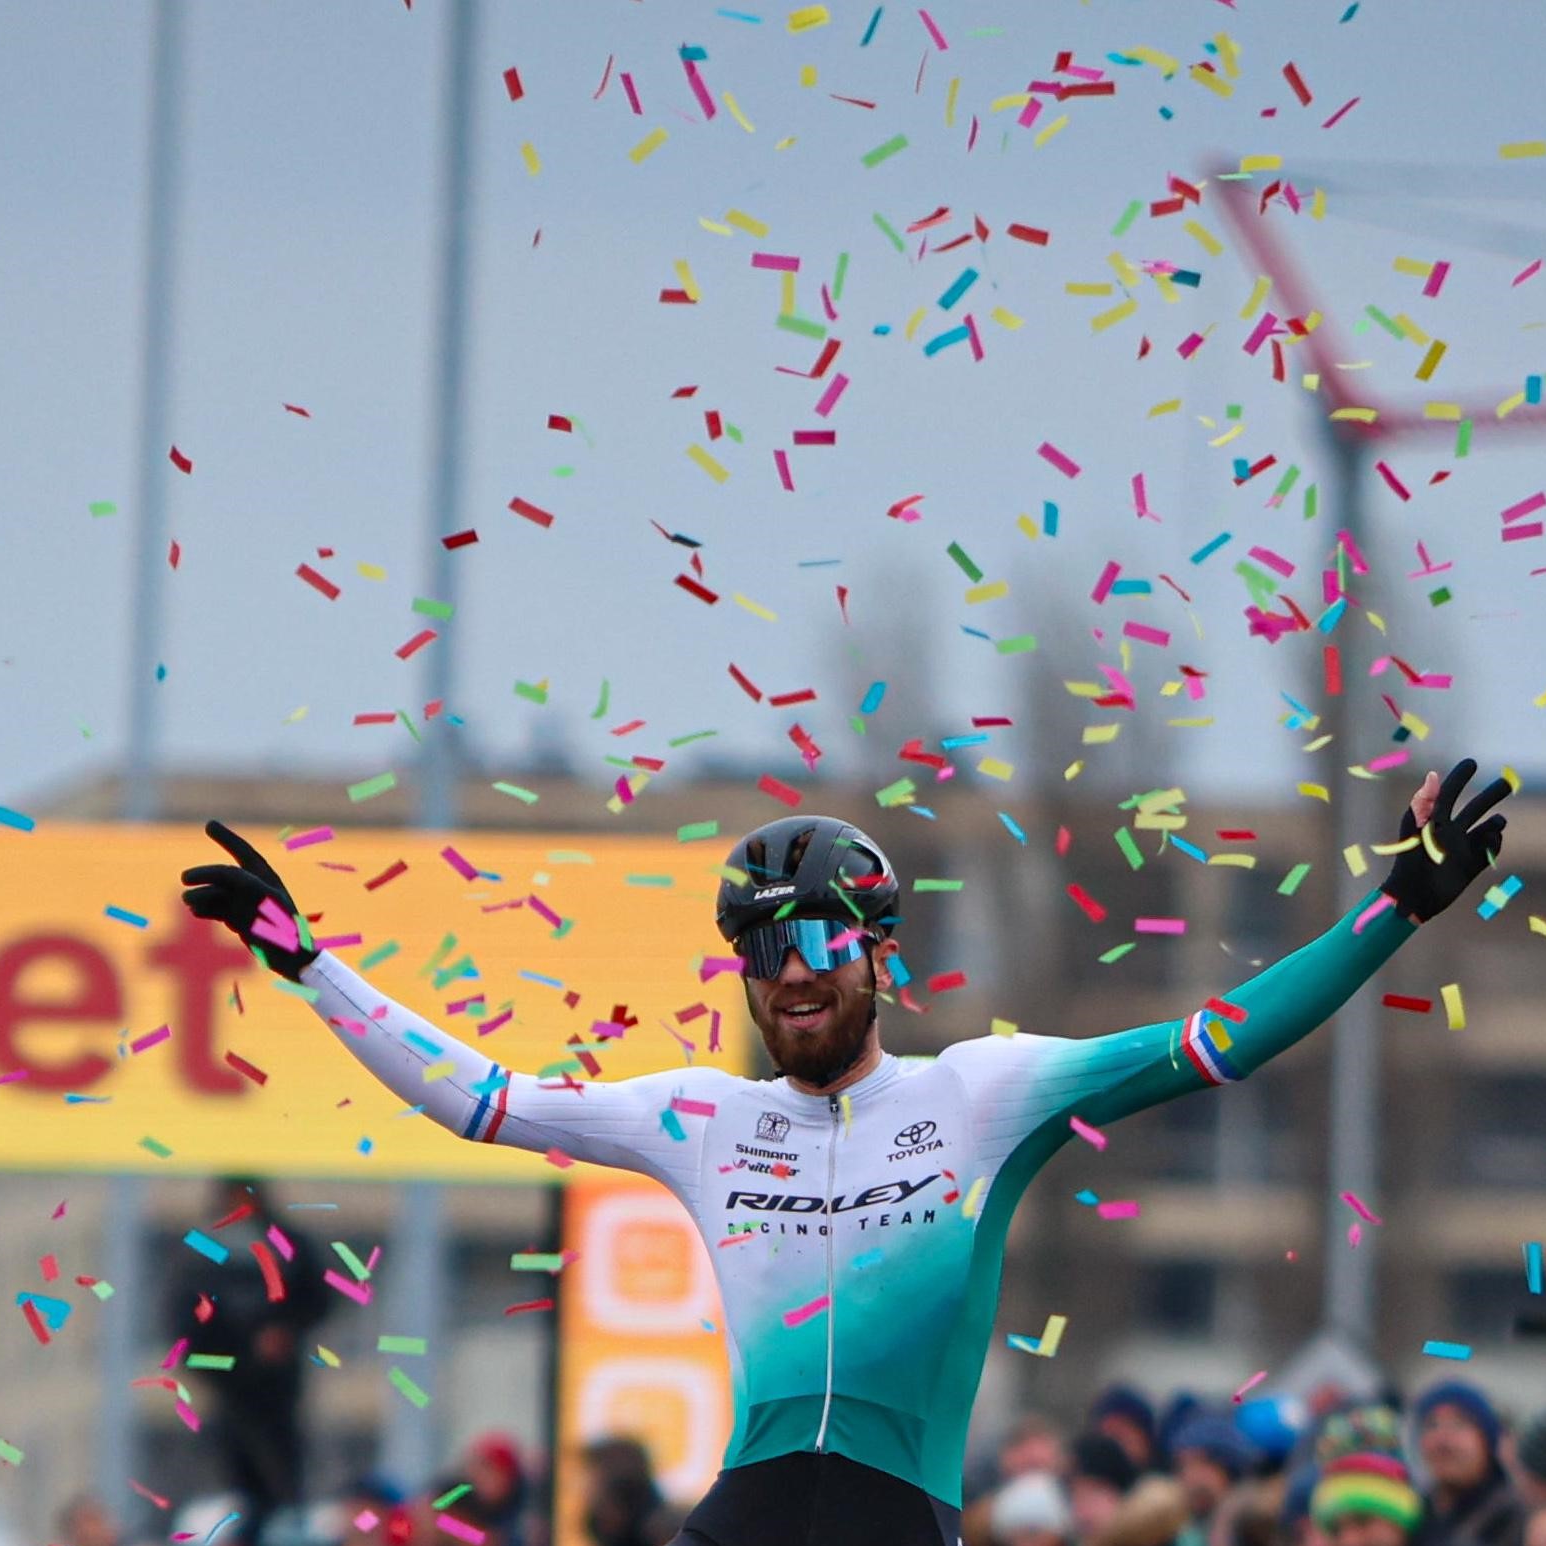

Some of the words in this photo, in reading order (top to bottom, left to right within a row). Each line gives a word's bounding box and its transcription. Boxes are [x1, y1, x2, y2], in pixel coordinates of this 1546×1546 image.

[754, 885, 796, 900] LAZER
[735, 1143, 800, 1161] SHIMANO
[886, 1139, 944, 1162] TOYOTA
[747, 1161, 801, 1177] vitta
[725, 1174, 941, 1215] RIDLEY
[727, 1222, 833, 1236] RACING
[859, 1209, 935, 1230] TEAM
